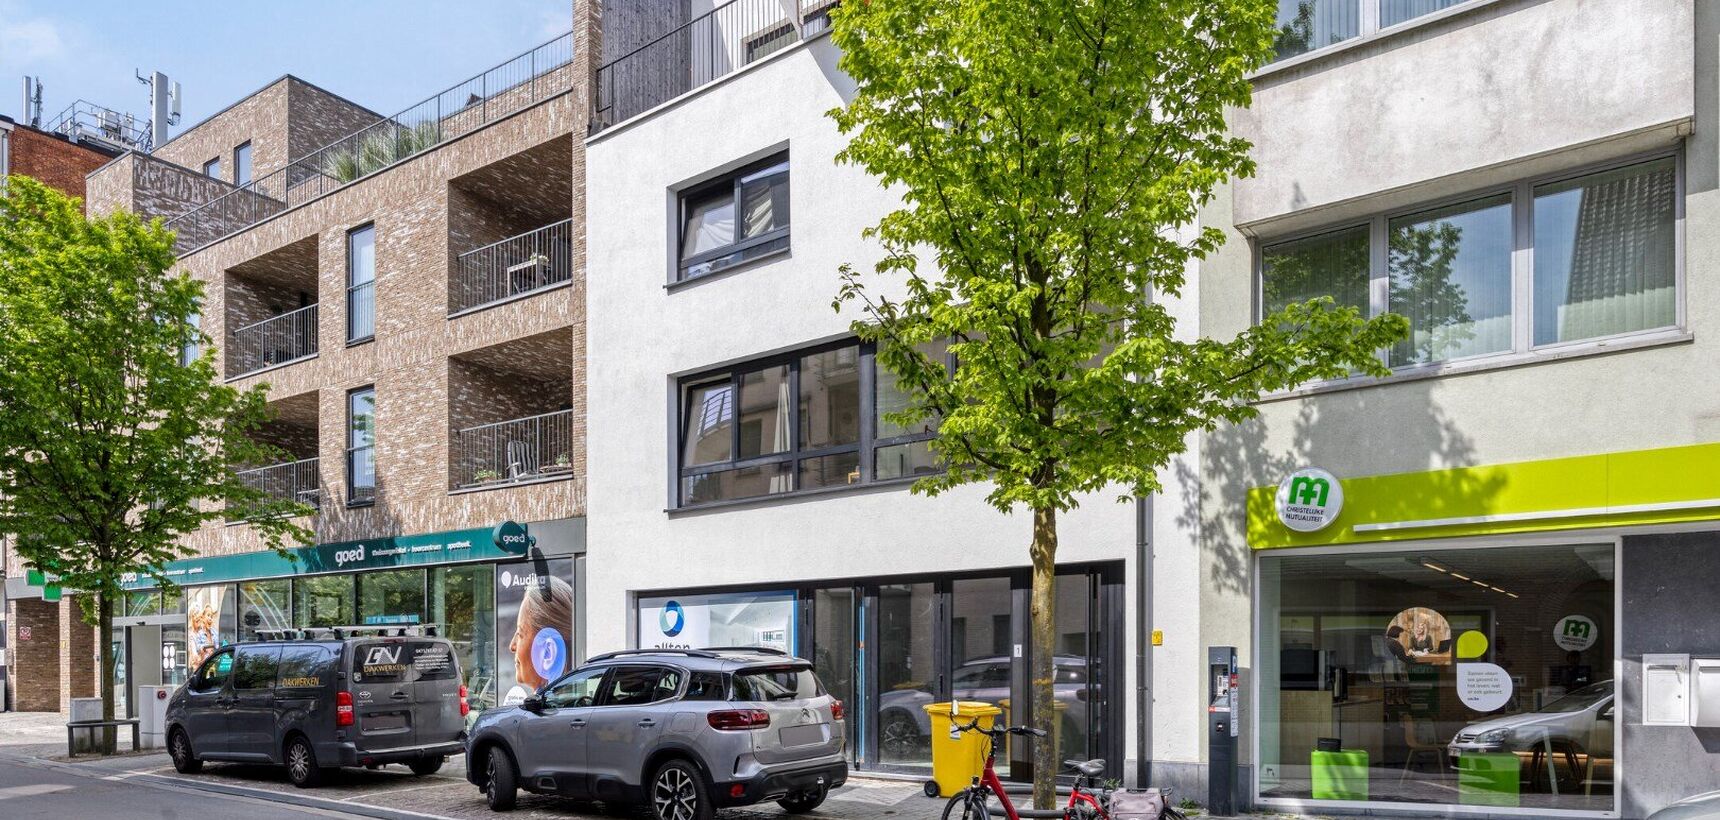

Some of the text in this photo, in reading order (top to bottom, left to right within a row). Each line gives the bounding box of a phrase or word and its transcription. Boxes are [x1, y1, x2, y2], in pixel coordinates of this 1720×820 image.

[1286, 506, 1324, 515] CHRISTELIJKE
[1286, 513, 1323, 522] MUTUALITEIT
[503, 534, 525, 544] goed
[335, 544, 365, 567] goed
[512, 573, 546, 586] Audika
[363, 664, 407, 673] DAKWERKEN
[282, 677, 319, 688] DAKWERKEN
